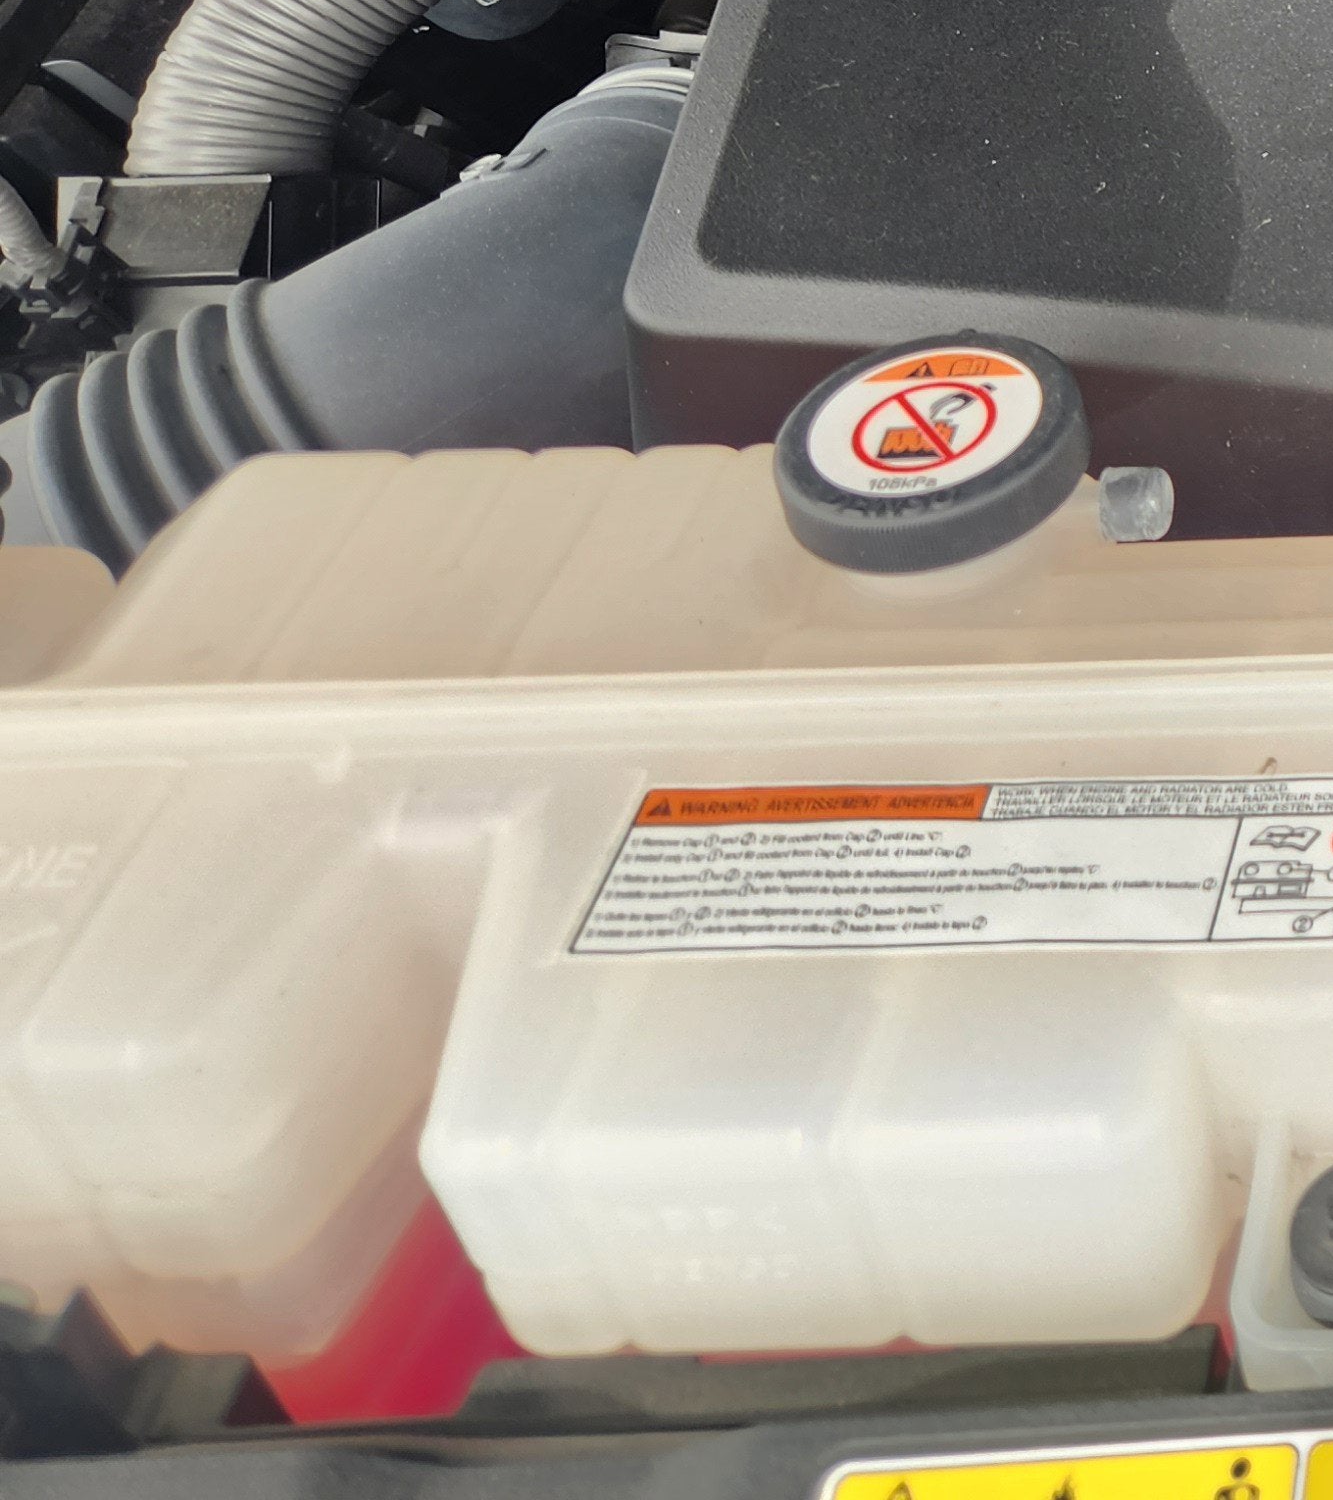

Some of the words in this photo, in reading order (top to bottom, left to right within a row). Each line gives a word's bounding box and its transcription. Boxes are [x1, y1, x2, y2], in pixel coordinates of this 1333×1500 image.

[868, 475, 938, 491] 108kPa
[1039, 785, 1077, 795] WHEN
[1080, 785, 1126, 795] ENGINE
[1130, 784, 1155, 794] AND
[1159, 784, 1223, 794] RADIATOR
[1225, 784, 1249, 793] ARE
[1131, 794, 1147, 804] LE
[1150, 793, 1204, 804] MOTEUR
[1242, 792, 1311, 803] RADIATEUR
[680, 798, 758, 815] WARNING
[766, 794, 881, 812] AVERTISSEMENT
[1124, 804, 1171, 815] MOTOR
[1204, 803, 1269, 814] RADIADOR
